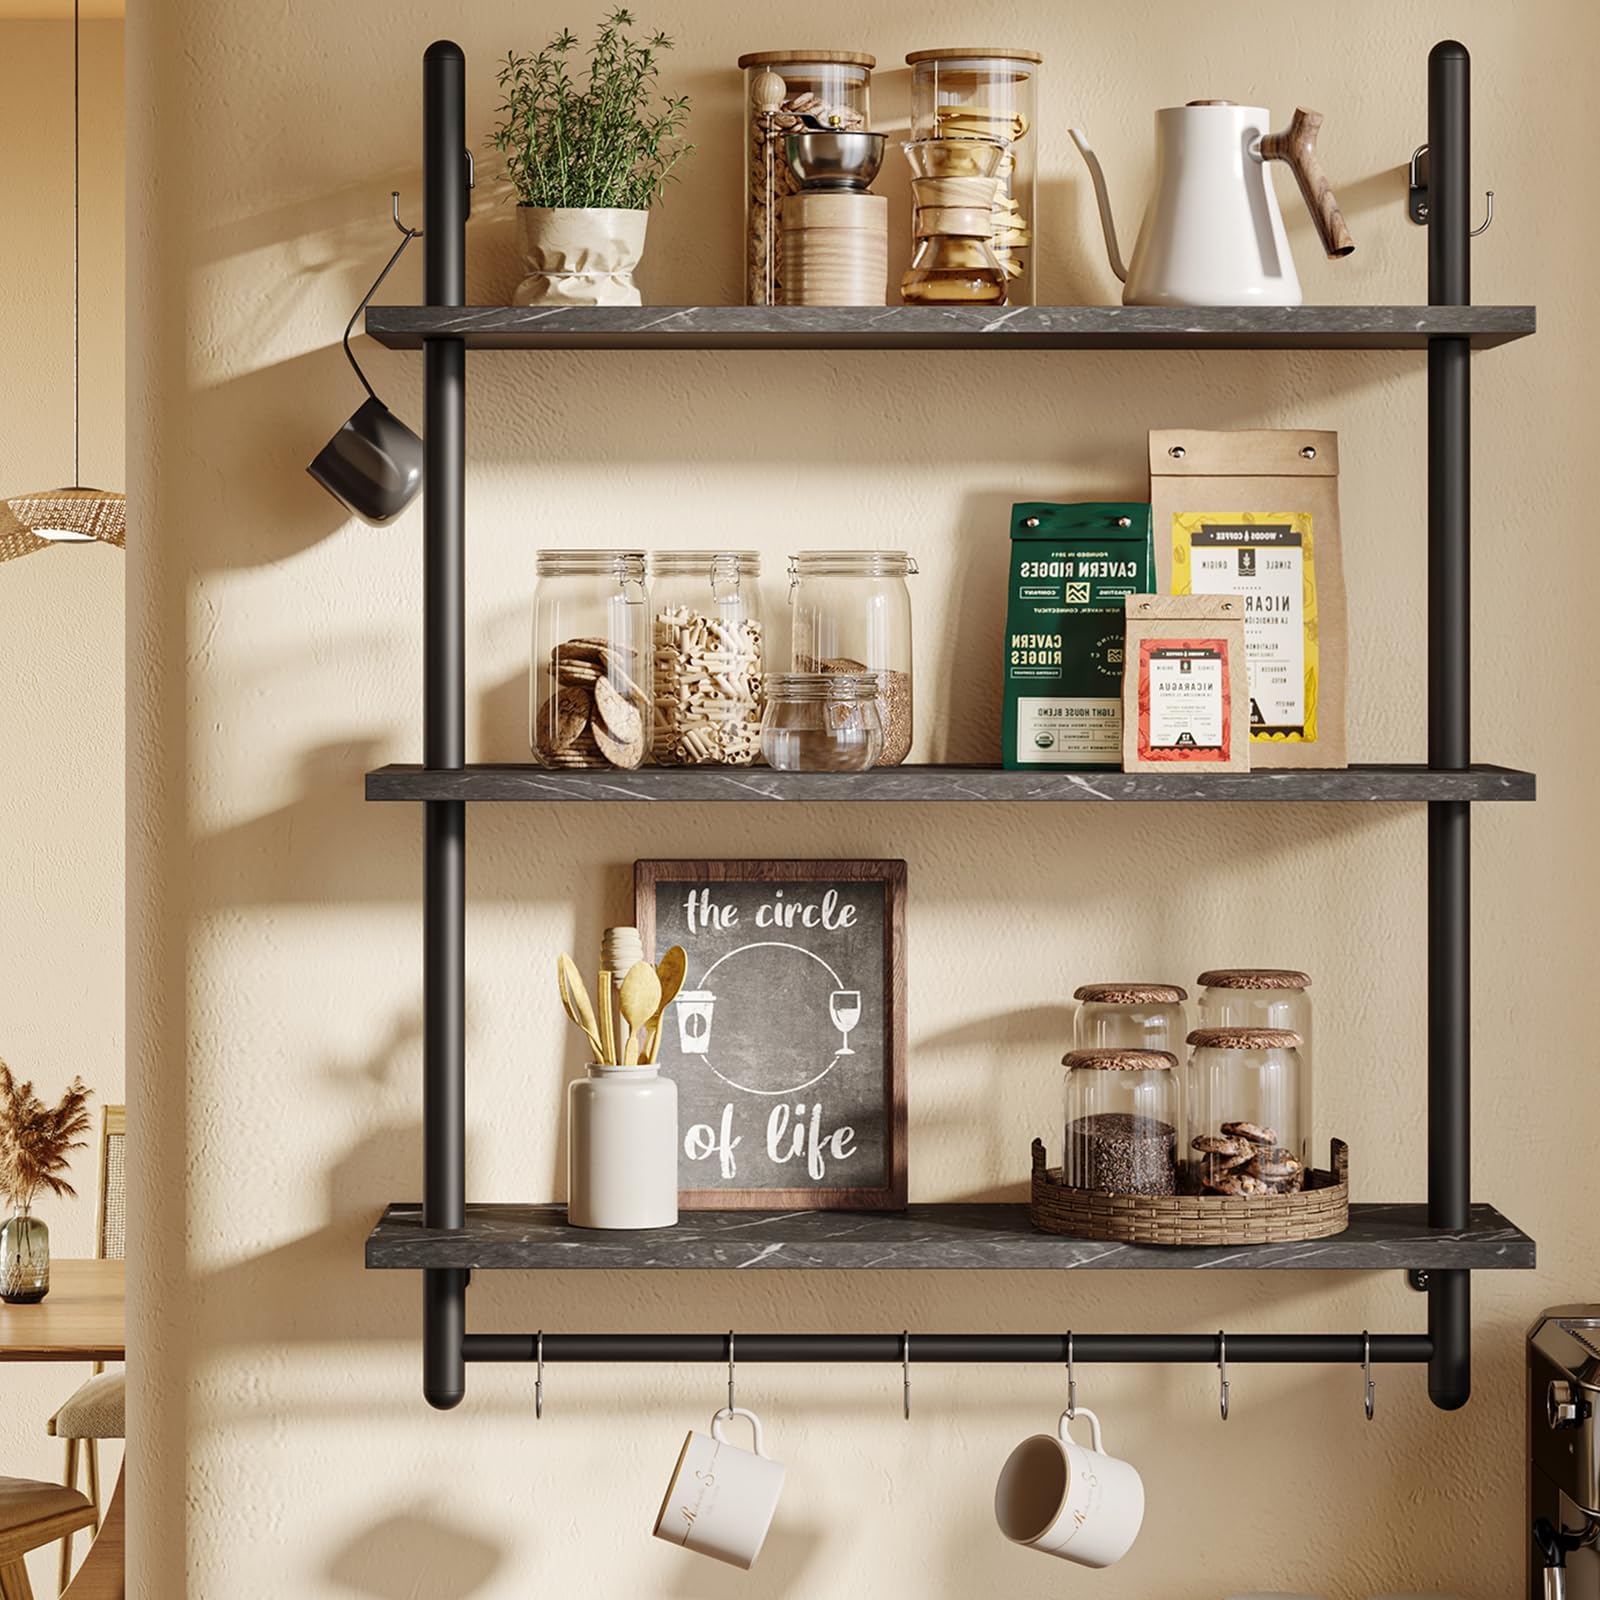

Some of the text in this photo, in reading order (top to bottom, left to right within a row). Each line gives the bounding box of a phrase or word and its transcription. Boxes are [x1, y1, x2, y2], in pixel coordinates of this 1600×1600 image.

[683, 888, 858, 934] the circle
[684, 1103, 857, 1180] of life
